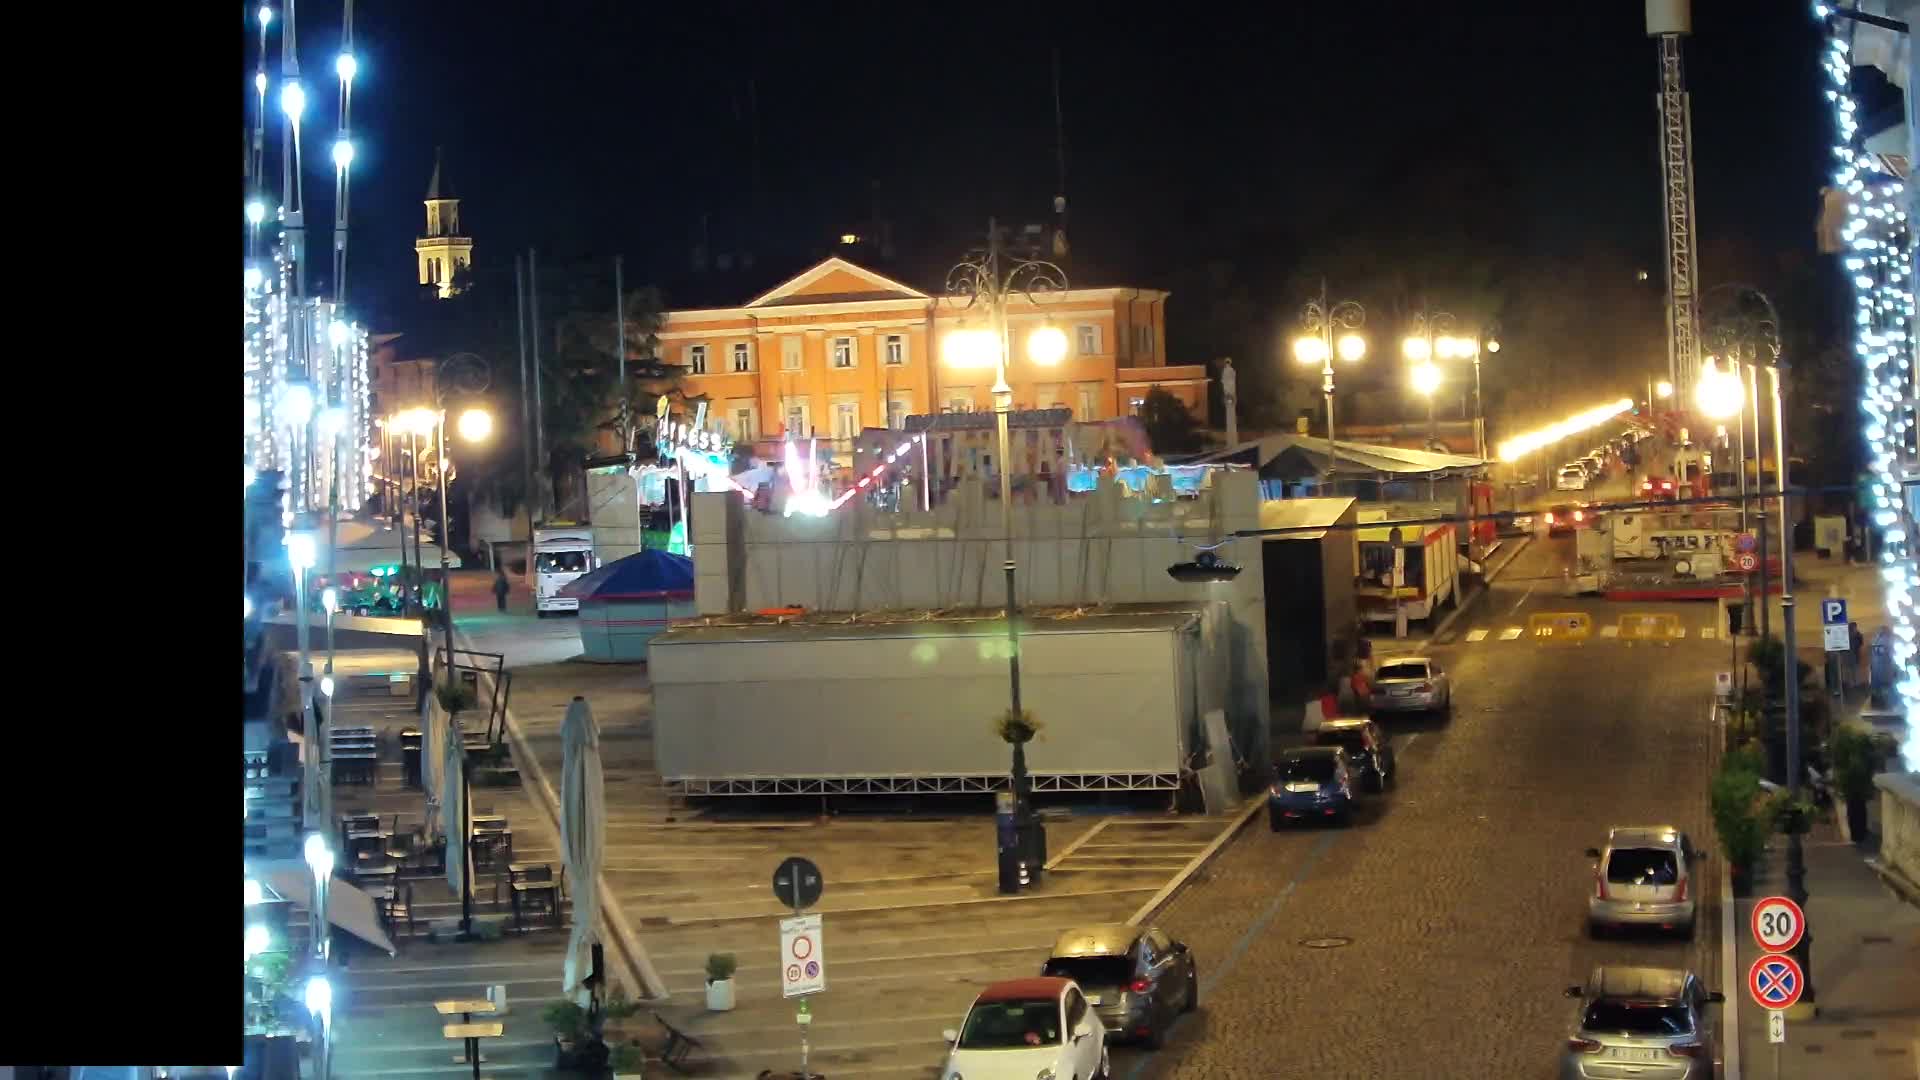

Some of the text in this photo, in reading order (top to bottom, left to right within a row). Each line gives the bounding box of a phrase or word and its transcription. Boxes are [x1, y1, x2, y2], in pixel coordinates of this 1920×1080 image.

[1743, 557, 1753, 567] 20
[1827, 602, 1842, 621] P
[1763, 912, 1792, 937] 30
